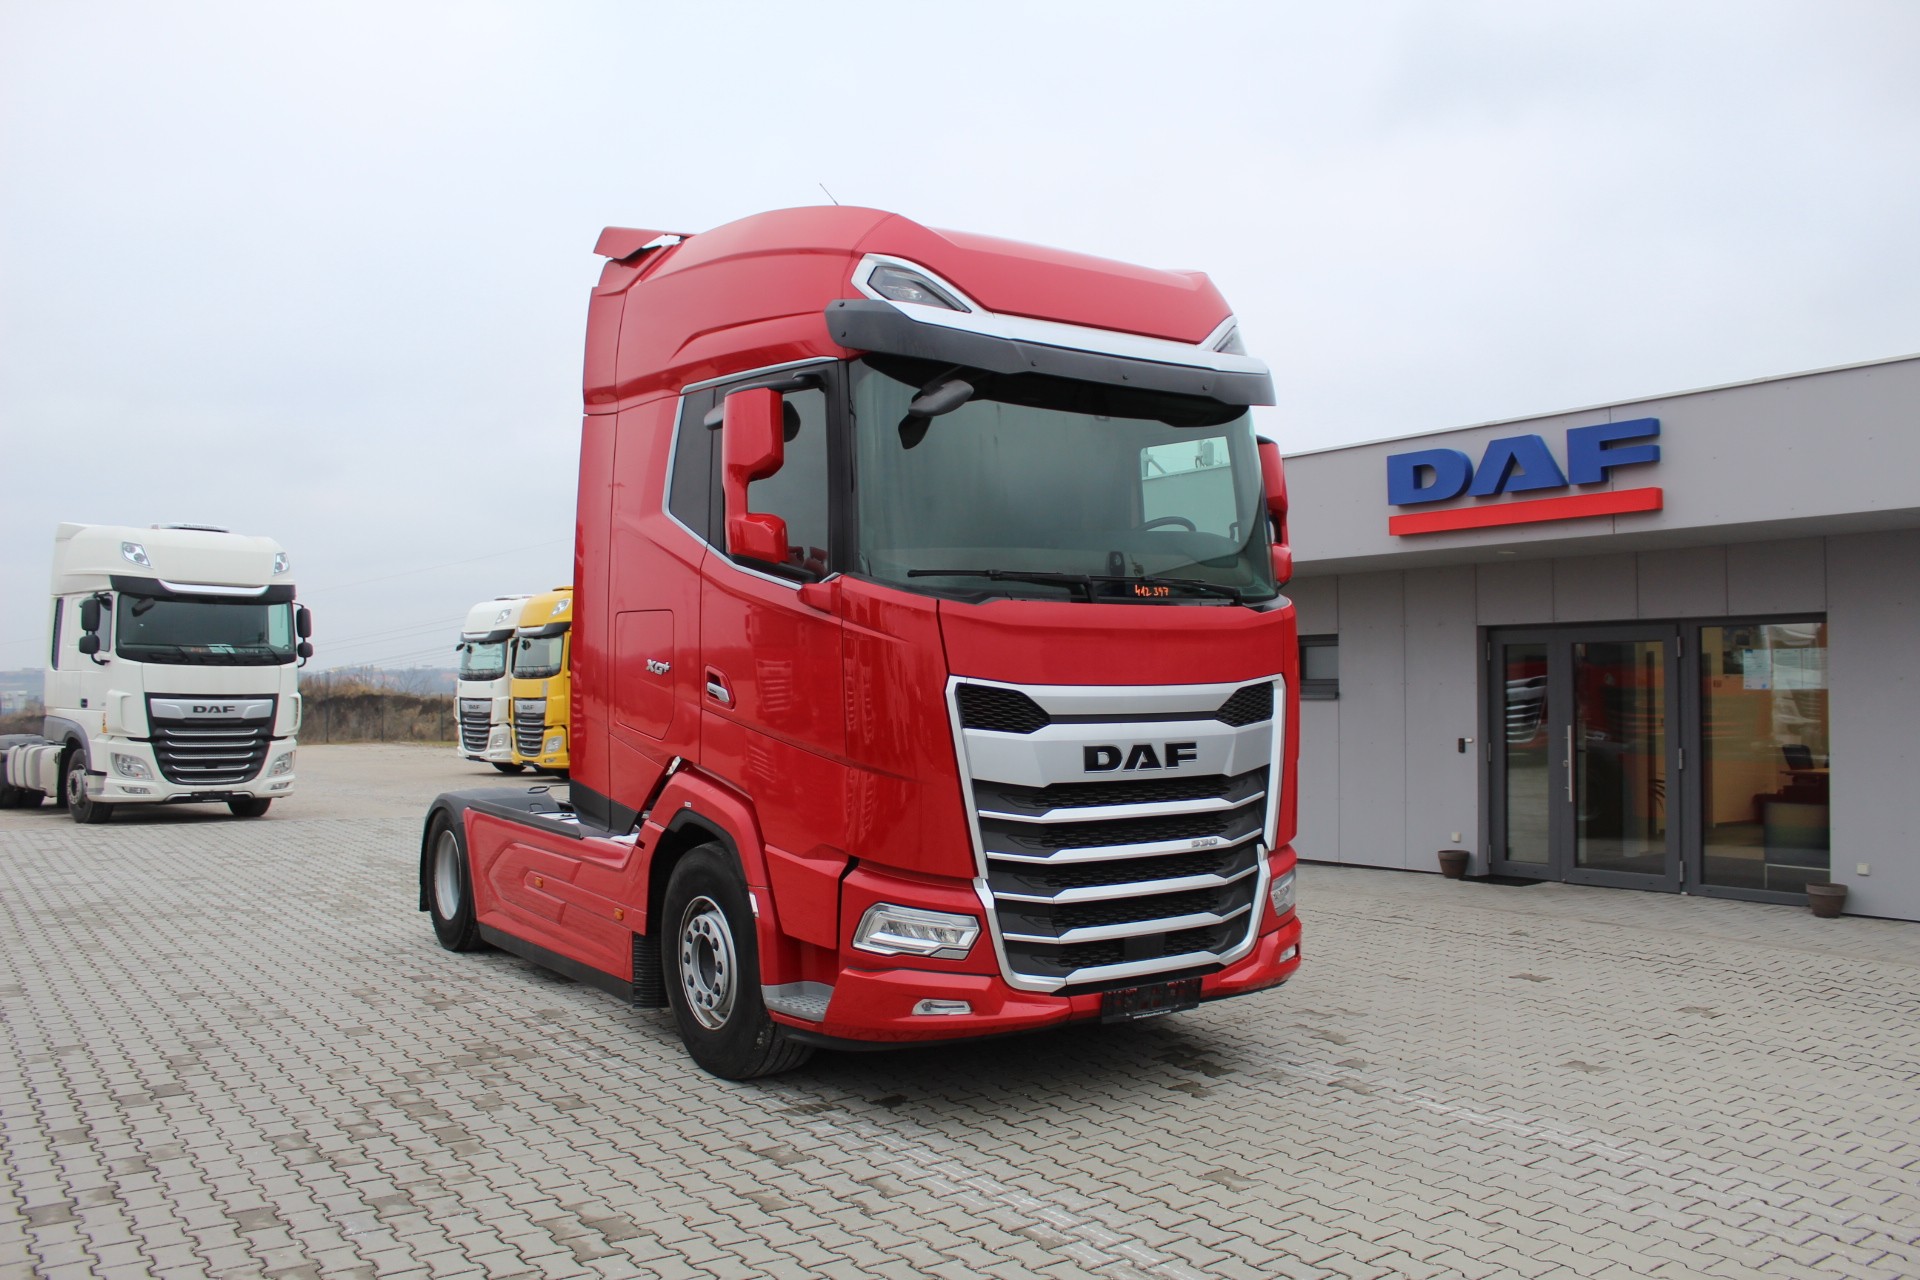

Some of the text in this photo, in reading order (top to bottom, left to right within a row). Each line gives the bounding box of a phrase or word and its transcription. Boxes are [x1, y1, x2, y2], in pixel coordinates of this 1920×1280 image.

[1387, 417, 1660, 506] DAF
[193, 705, 236, 713] DAF
[1083, 742, 1197, 773] DAF
